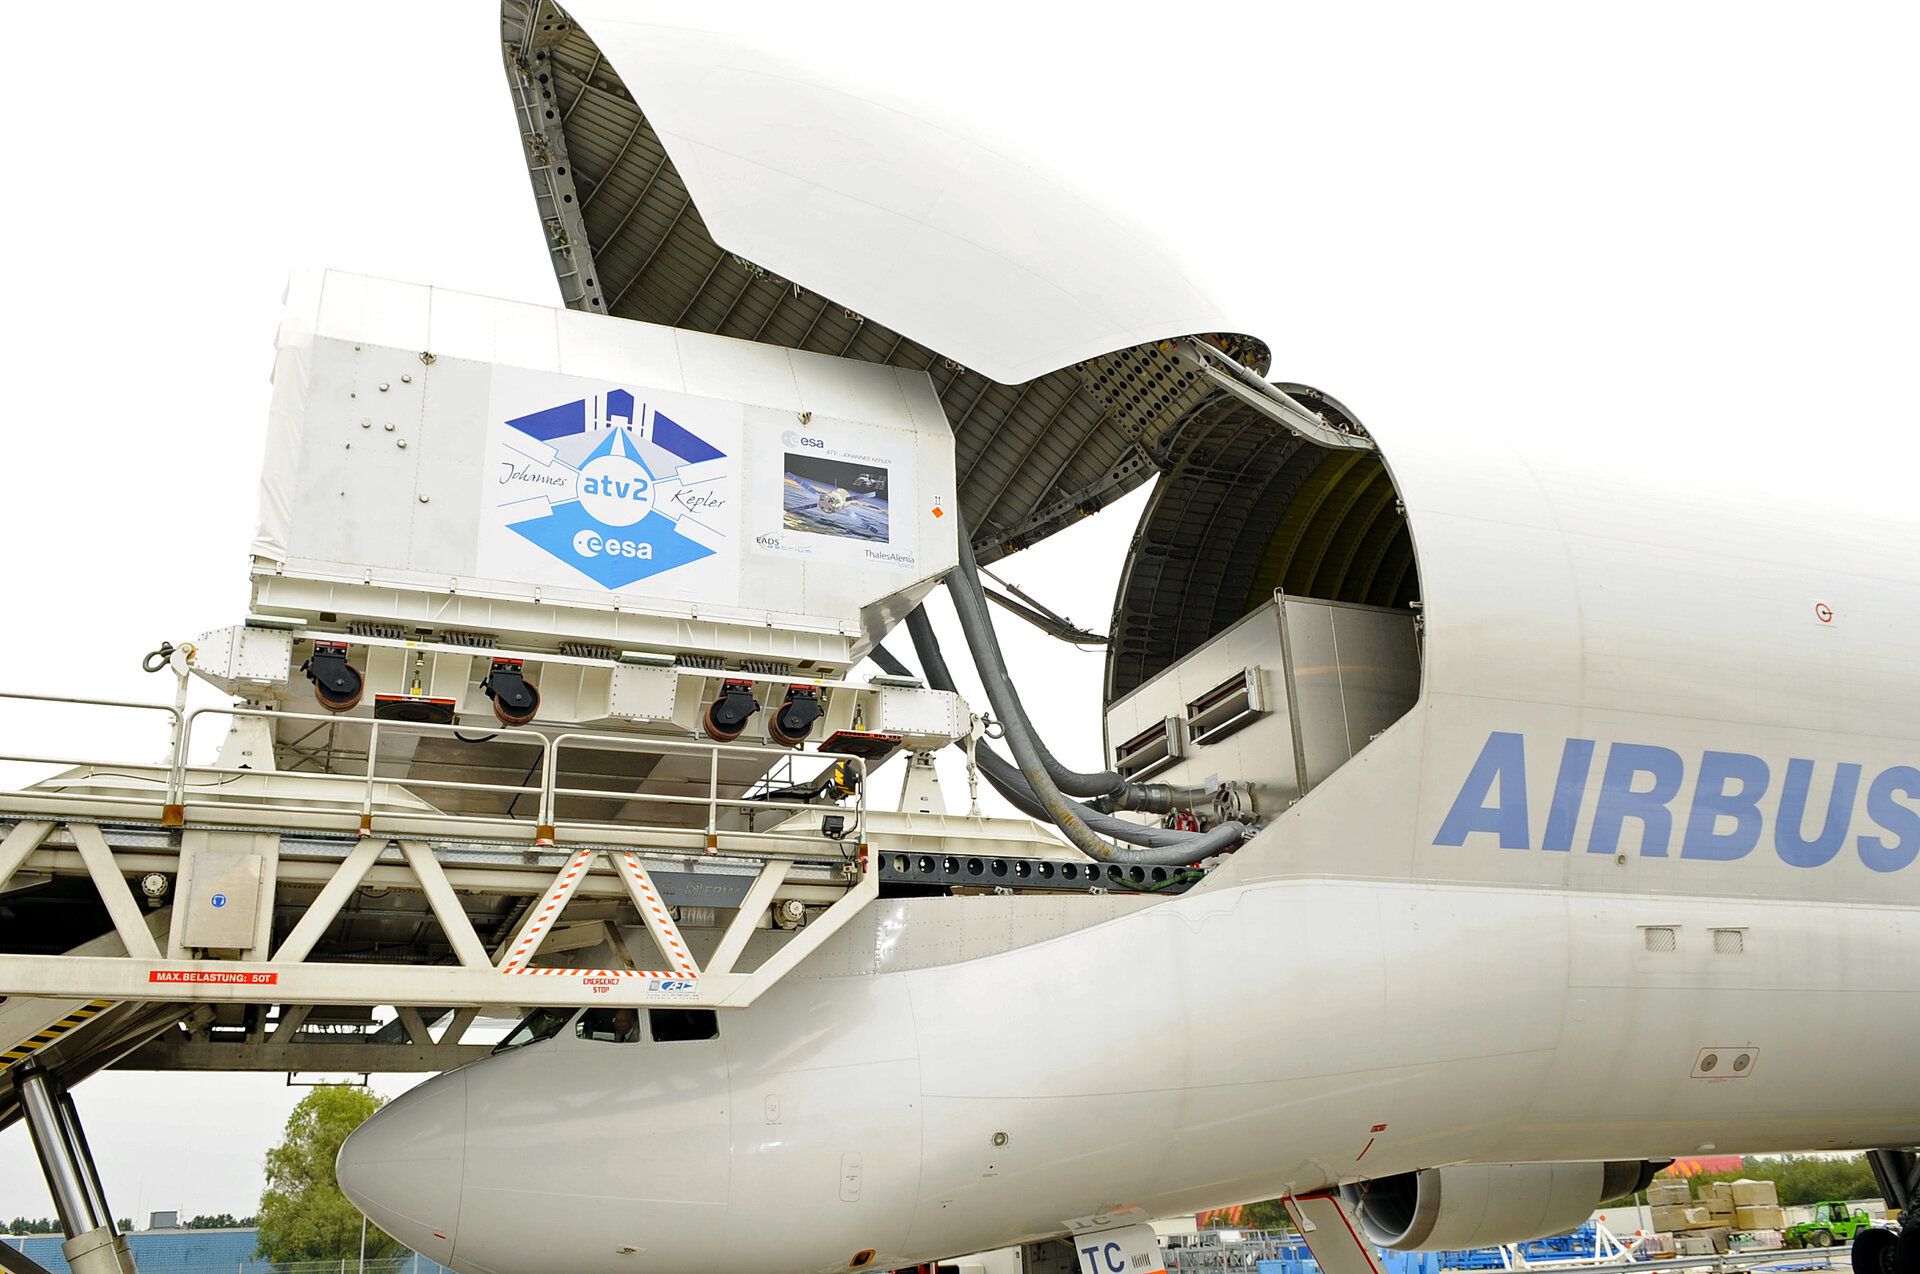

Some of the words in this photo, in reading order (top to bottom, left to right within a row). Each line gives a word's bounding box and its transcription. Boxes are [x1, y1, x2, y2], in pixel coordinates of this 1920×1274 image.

[800, 437, 824, 449] esa
[499, 462, 568, 487] Johannes
[583, 475, 649, 502] atv2
[670, 489, 727, 514] Kepler
[605, 538, 653, 560] esa
[756, 536, 780, 546] EADS
[864, 549, 915, 564] ThalesAlenia
[1431, 731, 1920, 874] AIRBUS
[252, 974, 271, 983] 50T
[1081, 1242, 1125, 1274] TC
